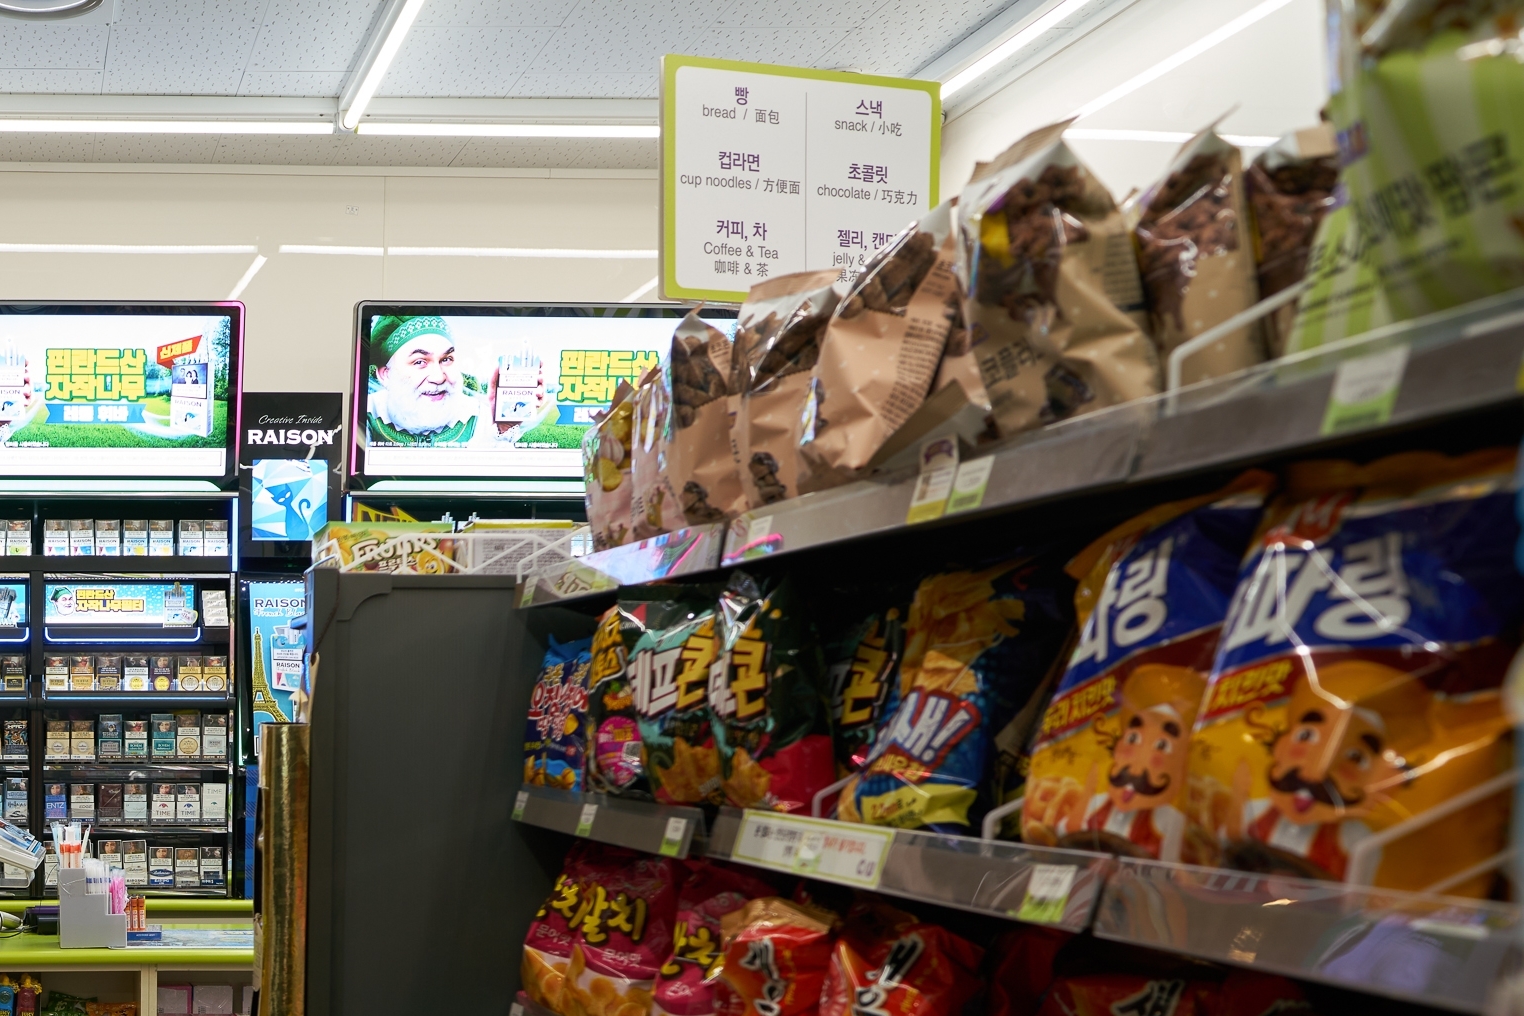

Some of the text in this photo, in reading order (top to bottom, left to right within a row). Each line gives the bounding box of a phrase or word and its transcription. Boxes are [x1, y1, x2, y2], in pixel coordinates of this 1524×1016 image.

[734, 87, 749, 105] 빵
[702, 104, 780, 125] bread 面包
[855, 100, 883, 118] 스낵
[834, 119, 903, 137] snack 小吃
[718, 151, 761, 173] 컵라면
[848, 164, 888, 184] 초콜릿
[680, 173, 800, 195] cup noodles 方便面
[817, 185, 918, 206] chocolate 巧克力
[716, 220, 767, 242] 커피, 차
[837, 229, 868, 250] 젤리,
[703, 242, 779, 260] Coffee & Tea
[832, 252, 855, 267] jelly
[714, 260, 768, 277] 咖啡 & 茶
[46, 348, 146, 375] 핀란드산
[45, 374, 146, 401] 자작나무
[502, 389, 534, 397] RAISON
[174, 399, 203, 408] RAISON
[258, 414, 323, 425] Creative Inside
[247, 429, 334, 446] RAISON
[255, 598, 306, 608] RAISON
